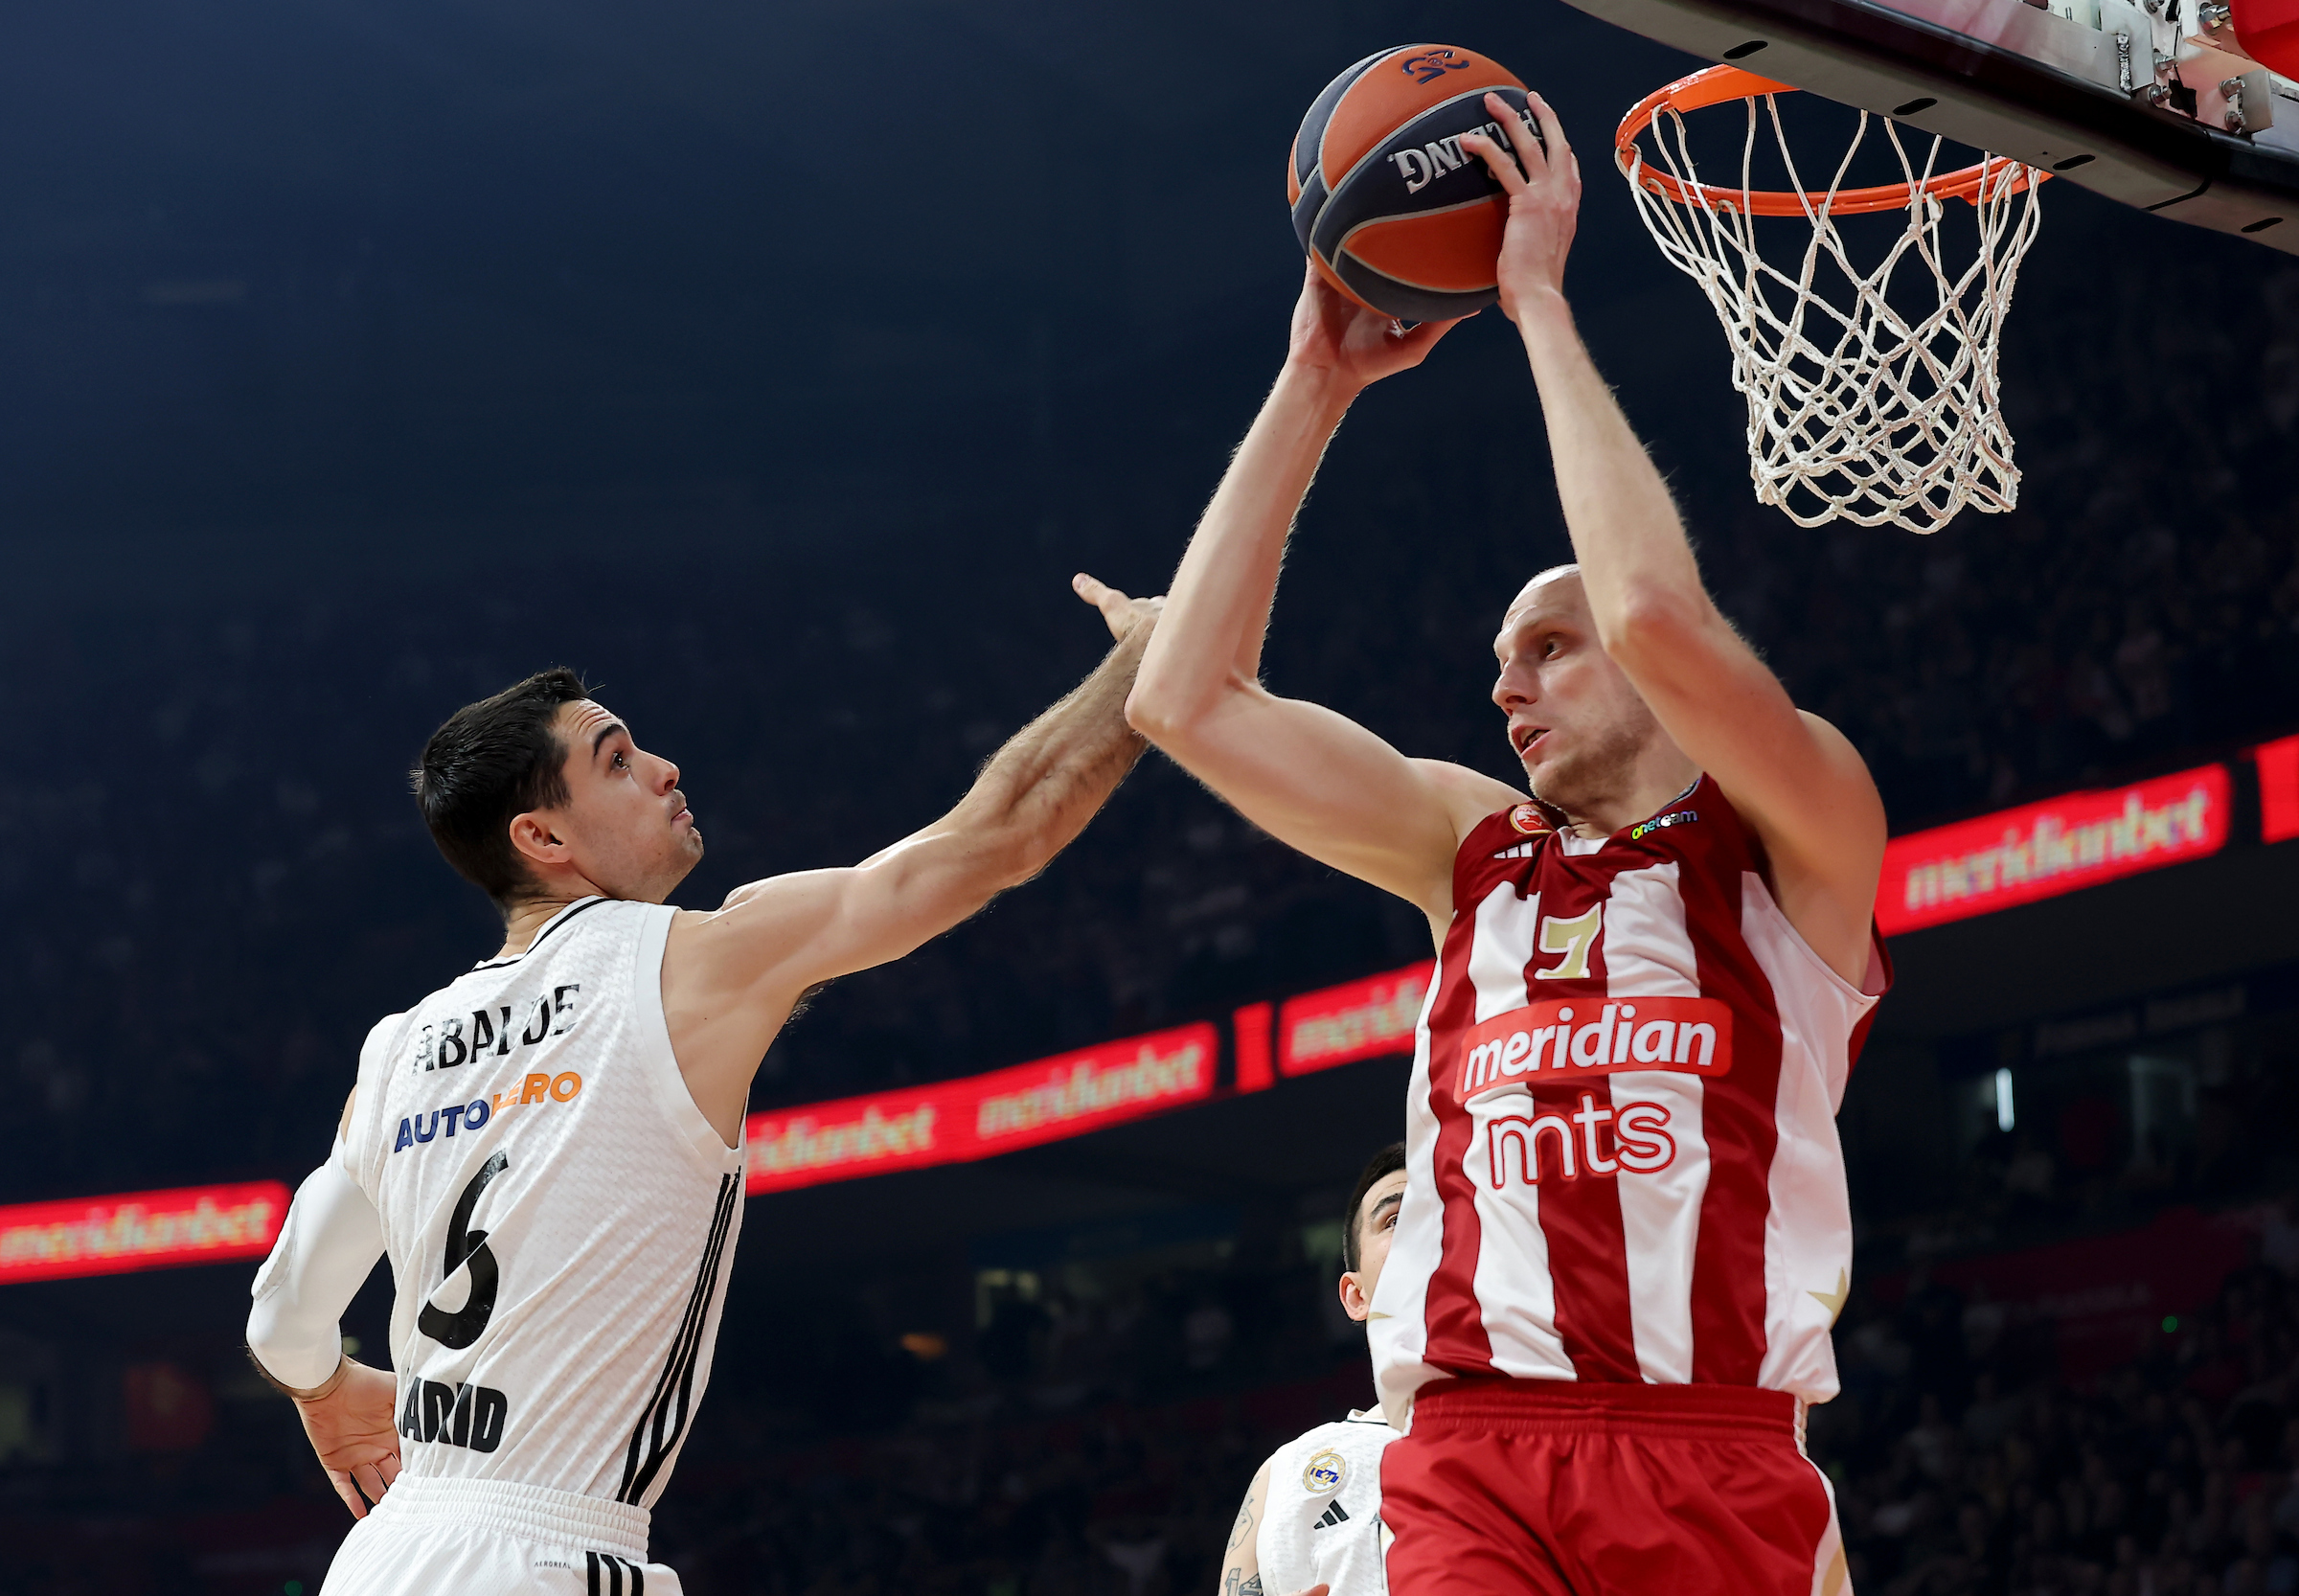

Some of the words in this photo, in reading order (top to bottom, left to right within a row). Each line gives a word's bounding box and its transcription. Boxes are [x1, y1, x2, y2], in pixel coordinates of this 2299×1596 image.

[1631, 810, 1698, 839] oneteam
[1463, 1004, 1718, 1094] meridian
[1488, 1091, 1675, 1190] mts
[418, 1150, 508, 1350] 6
